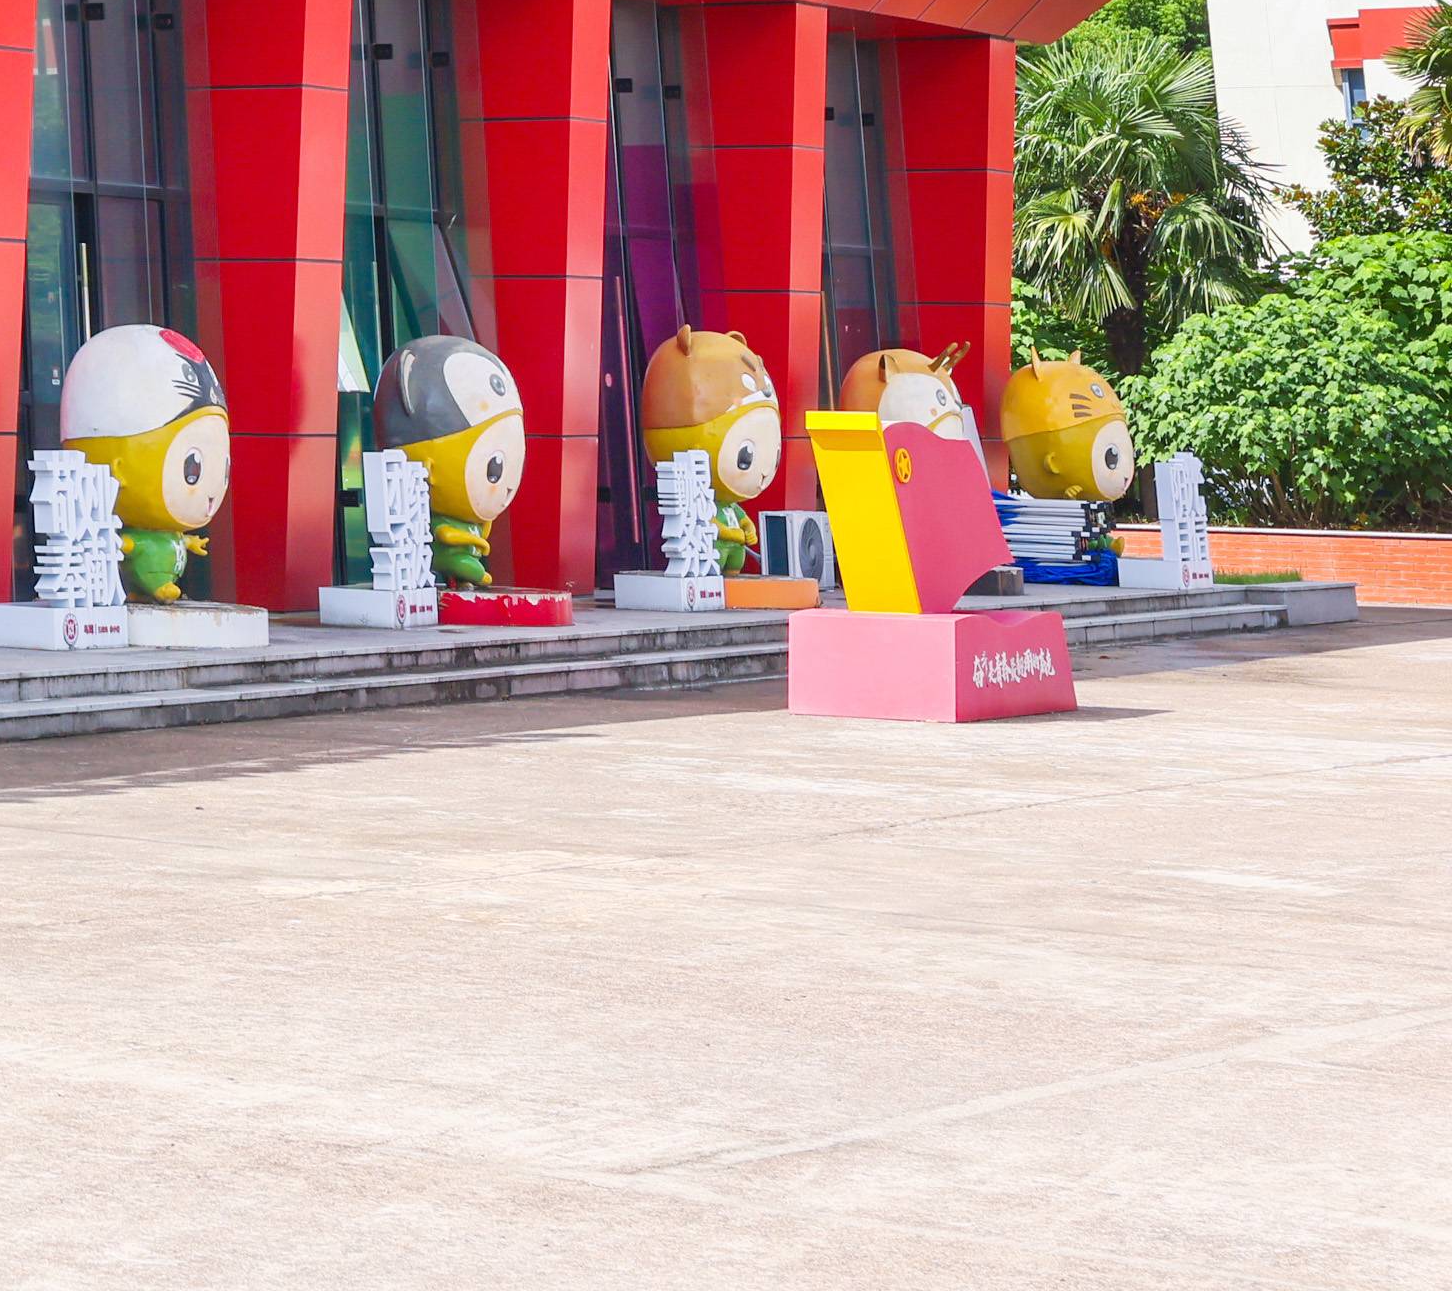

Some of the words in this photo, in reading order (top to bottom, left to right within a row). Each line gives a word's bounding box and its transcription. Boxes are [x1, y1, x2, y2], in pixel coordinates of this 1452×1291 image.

[28, 450, 124, 542] 敬业
[363, 449, 434, 544] 团结
[655, 450, 718, 538] 勤恳
[33, 527, 127, 608] 奉献
[661, 522, 721, 578] 务实
